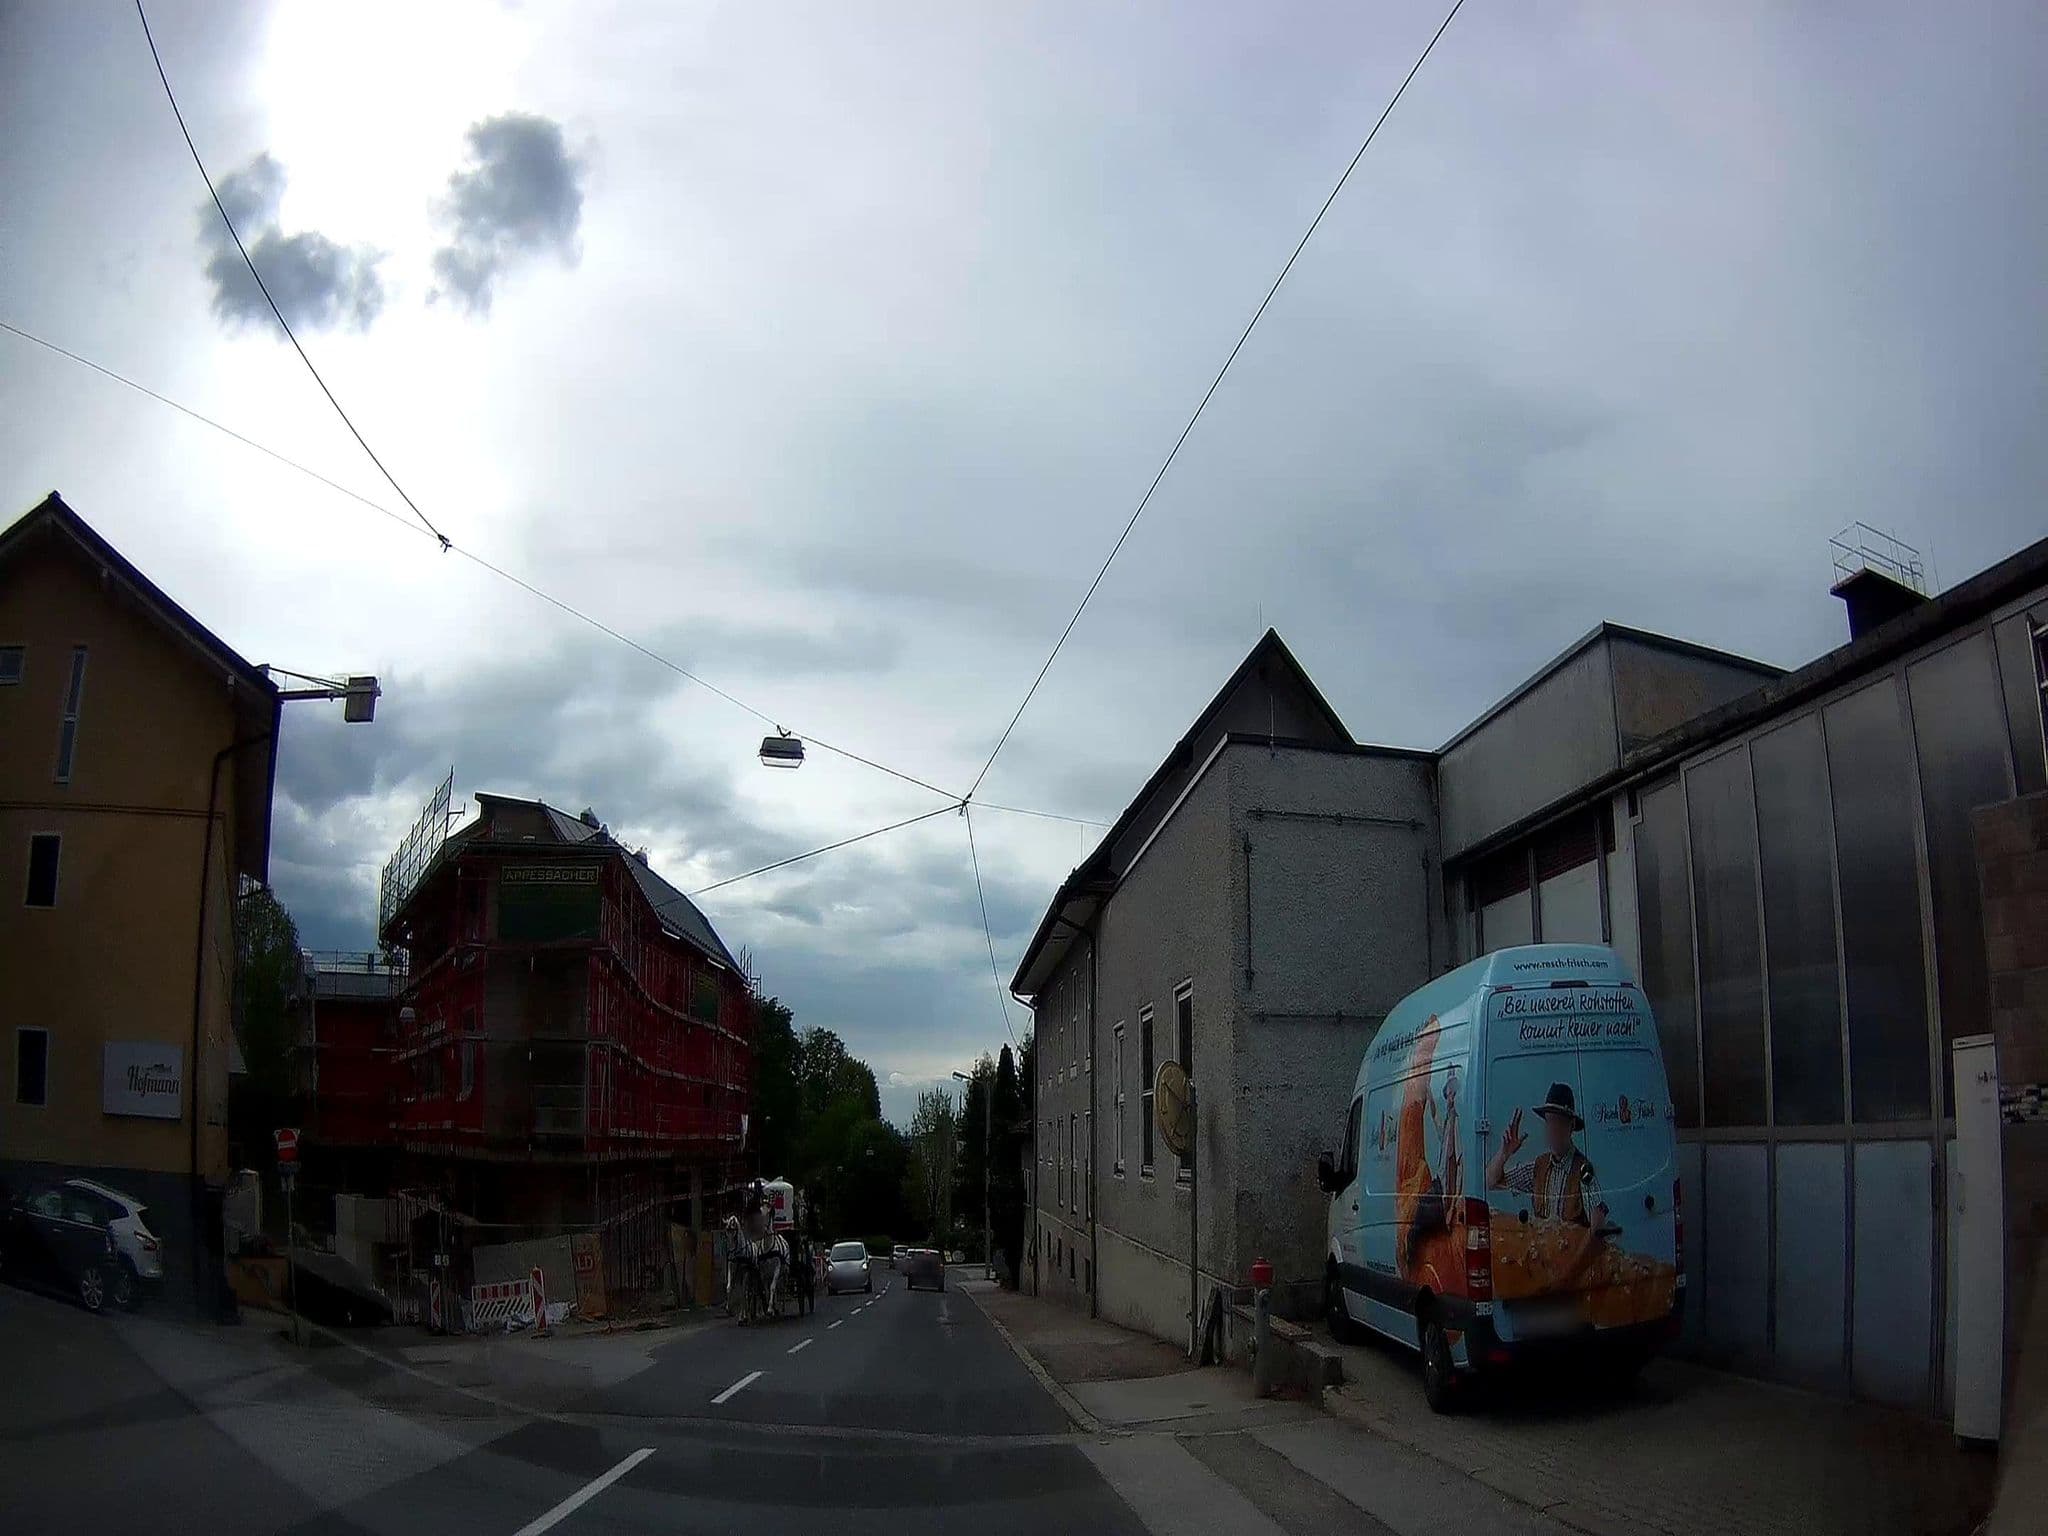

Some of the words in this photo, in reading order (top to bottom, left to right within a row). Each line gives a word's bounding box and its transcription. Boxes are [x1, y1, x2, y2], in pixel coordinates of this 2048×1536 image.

[1530, 996, 1575, 1014] unseren
[1580, 990, 1634, 1013] Rohstoffen
[1519, 1019, 1565, 1040] kommt
[1567, 1015, 1602, 1038] keiner
[127, 1065, 180, 1098] Hofmann
